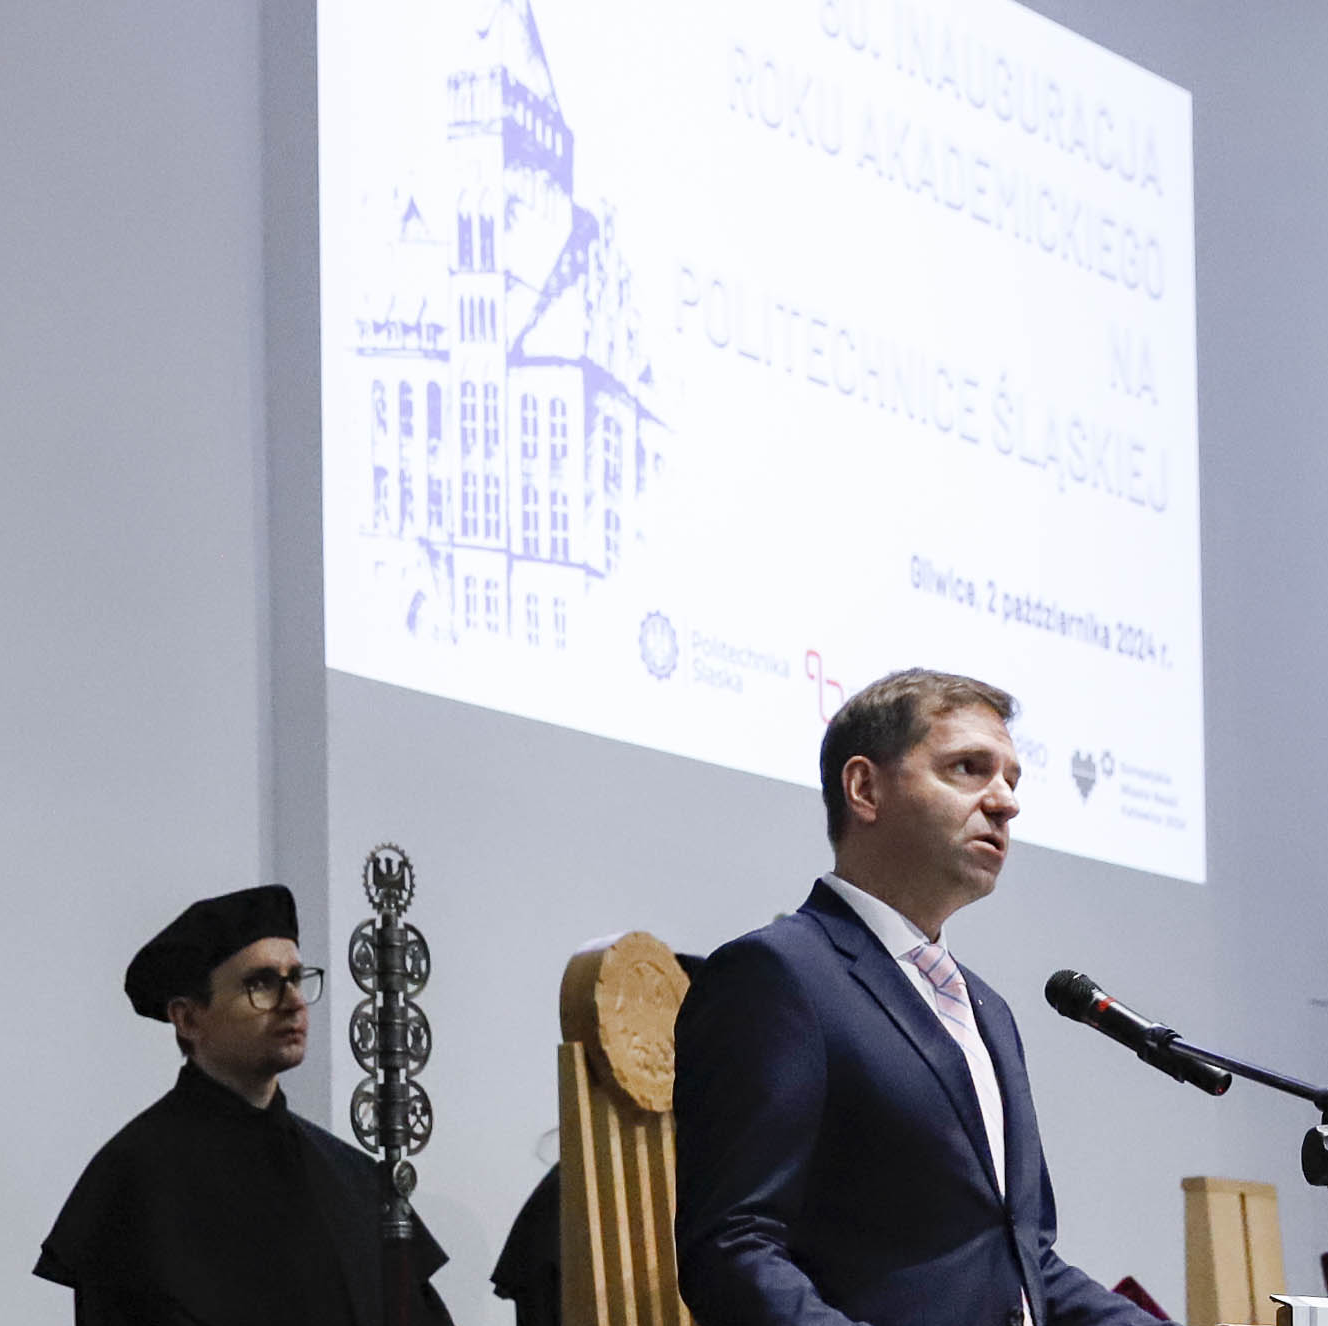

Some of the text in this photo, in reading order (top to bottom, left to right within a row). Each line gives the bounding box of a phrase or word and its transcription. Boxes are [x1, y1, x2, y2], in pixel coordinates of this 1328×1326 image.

[728, 40, 1166, 301] ROKU AKADEMICKIEGO
[896, 2, 1165, 197] INAUGURACJA
[675, 256, 1169, 514] POLITECHNICE ŚLĄSKIEJ
[1107, 321, 1160, 406] NA
[987, 579, 997, 614] 2
[1115, 619, 1157, 661] 2024
